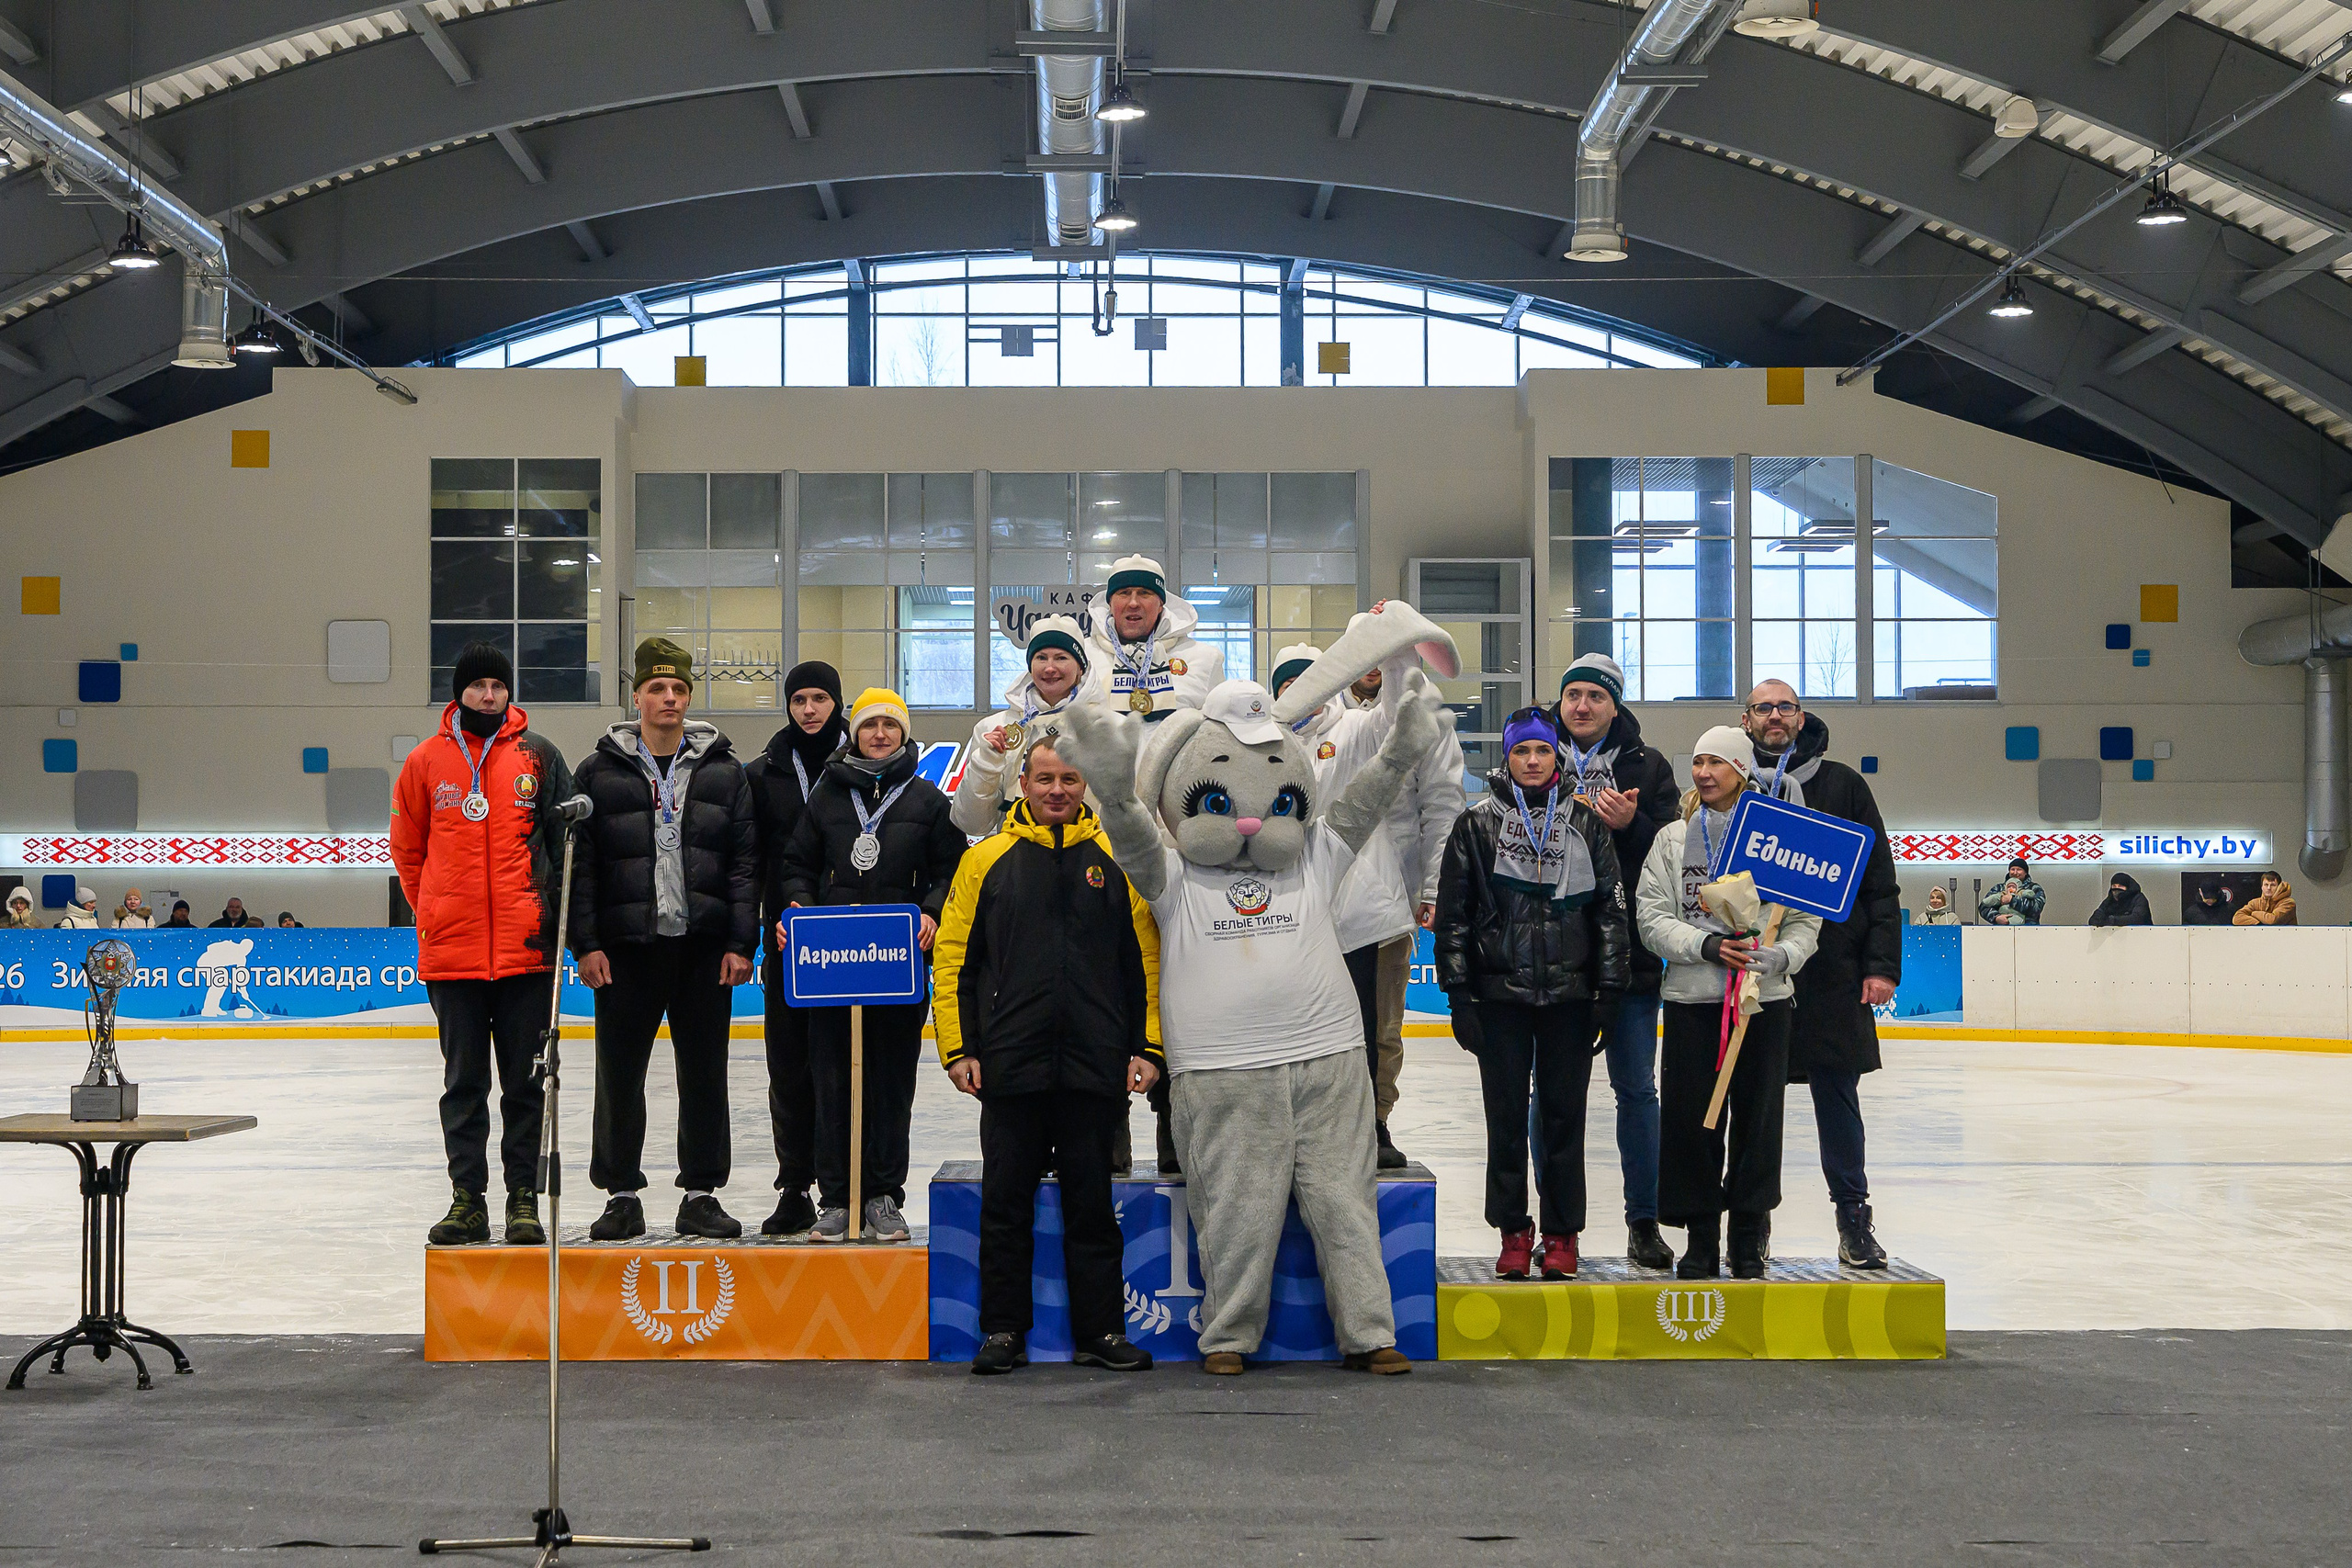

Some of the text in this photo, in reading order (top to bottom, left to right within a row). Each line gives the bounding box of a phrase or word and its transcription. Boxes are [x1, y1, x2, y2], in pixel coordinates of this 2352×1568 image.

[1050, 592, 1093, 605] КАФ
[1745, 830, 1842, 883] Единые
[2120, 835, 2257, 859] silichy.by
[1213, 913, 1294, 931] БЕЛЫЕ ТИГРЫ
[798, 942, 908, 970] Агрохолдинг
[51, 961, 168, 989] Зияя
[176, 965, 372, 994] спартакиада
[650, 1260, 705, 1314] II
[1668, 1292, 1714, 1322] III
